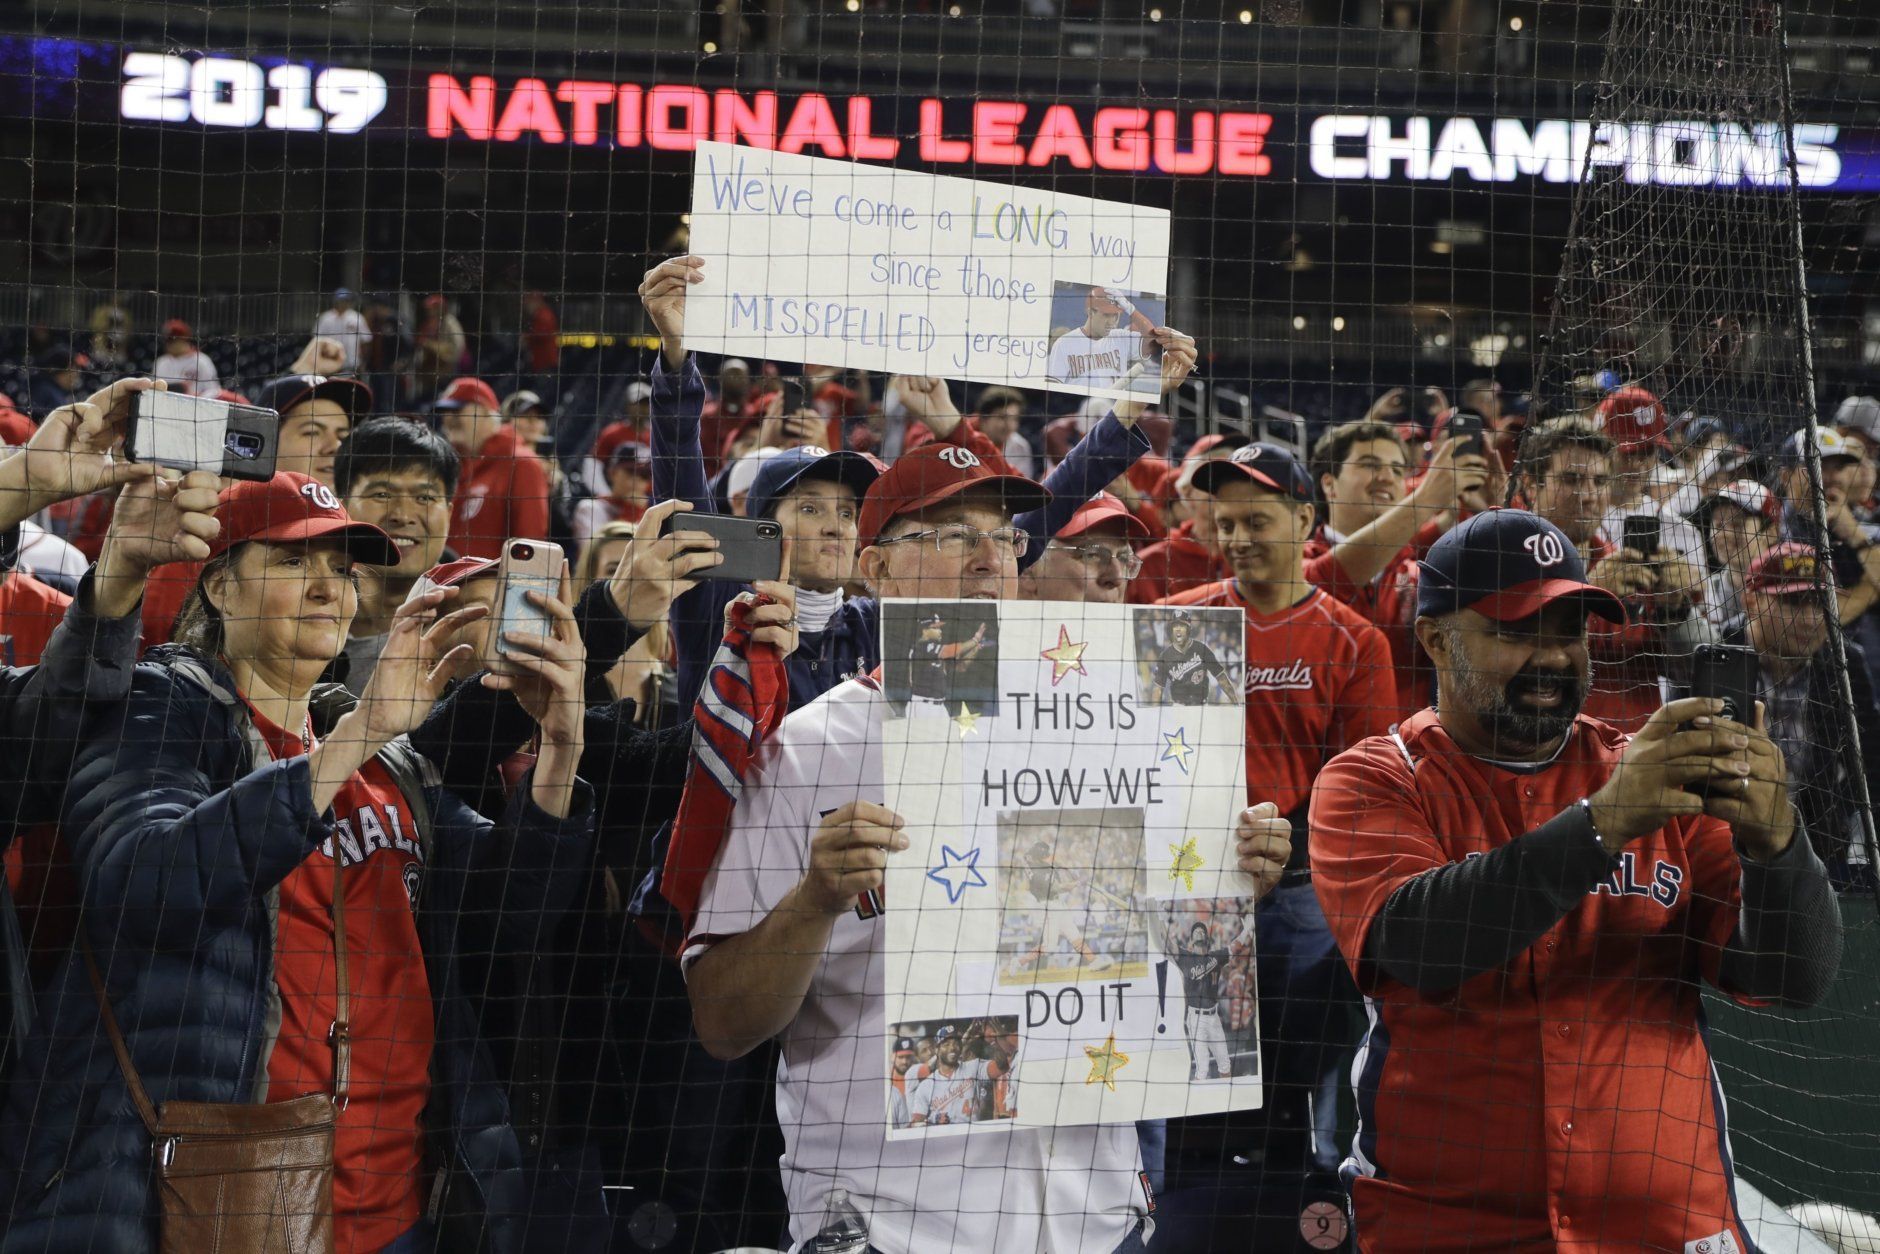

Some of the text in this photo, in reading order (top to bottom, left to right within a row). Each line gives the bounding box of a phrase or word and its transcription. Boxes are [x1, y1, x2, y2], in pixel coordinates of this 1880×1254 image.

[121, 52, 1841, 188] 2019 NATIONAL LEAGUE CHAMPIONS
[708, 153, 1136, 284] We've come a LONG way
[957, 255, 1037, 305] those
[731, 292, 1048, 379] MISSPELLED jerseys
[1067, 348, 1121, 379] NATINALS
[938, 446, 980, 468] W
[301, 482, 340, 509] W
[1523, 531, 1564, 566] W
[1006, 692, 1137, 730] THIS IS
[982, 767, 1164, 807] HOW-WE
[323, 805, 424, 867] NAL
[1025, 985, 1084, 1028] DO
[1100, 982, 1132, 1022] IT
[1316, 1215, 1330, 1235] 9
